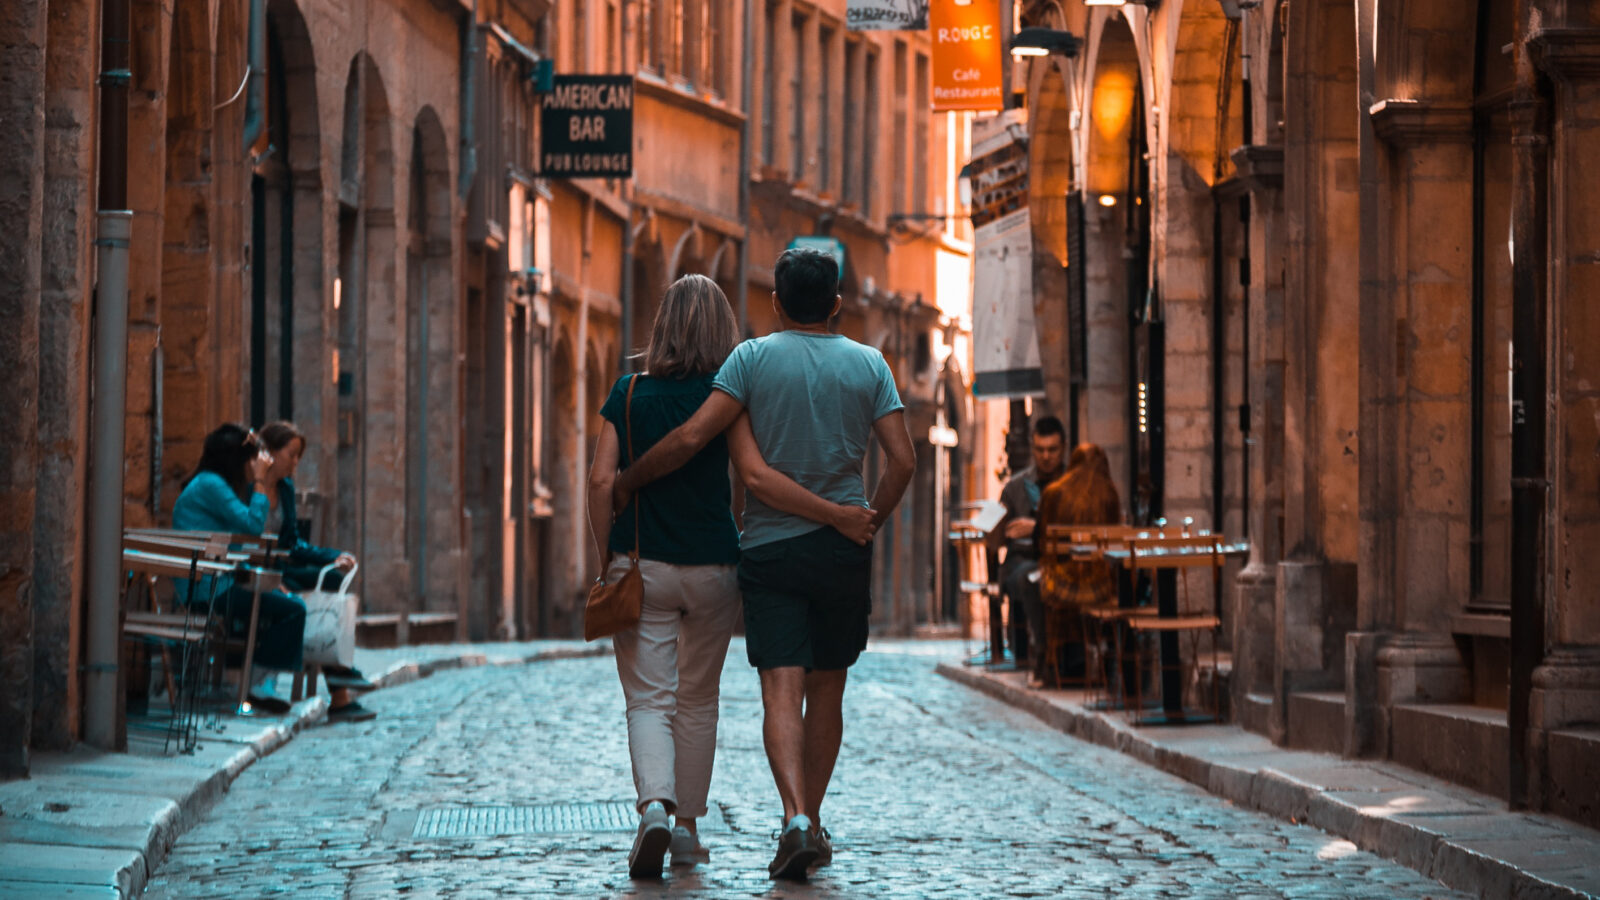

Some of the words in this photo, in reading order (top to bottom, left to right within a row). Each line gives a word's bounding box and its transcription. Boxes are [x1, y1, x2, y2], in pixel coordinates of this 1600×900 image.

[938, 25, 992, 44] ROUGE
[953, 68, 981, 81] Café
[543, 84, 631, 109] AMERICAN
[934, 86, 1000, 98] Restaurant
[569, 116, 606, 141] BAR
[545, 154, 571, 171] PUB
[574, 154, 628, 171] LOUNGE
